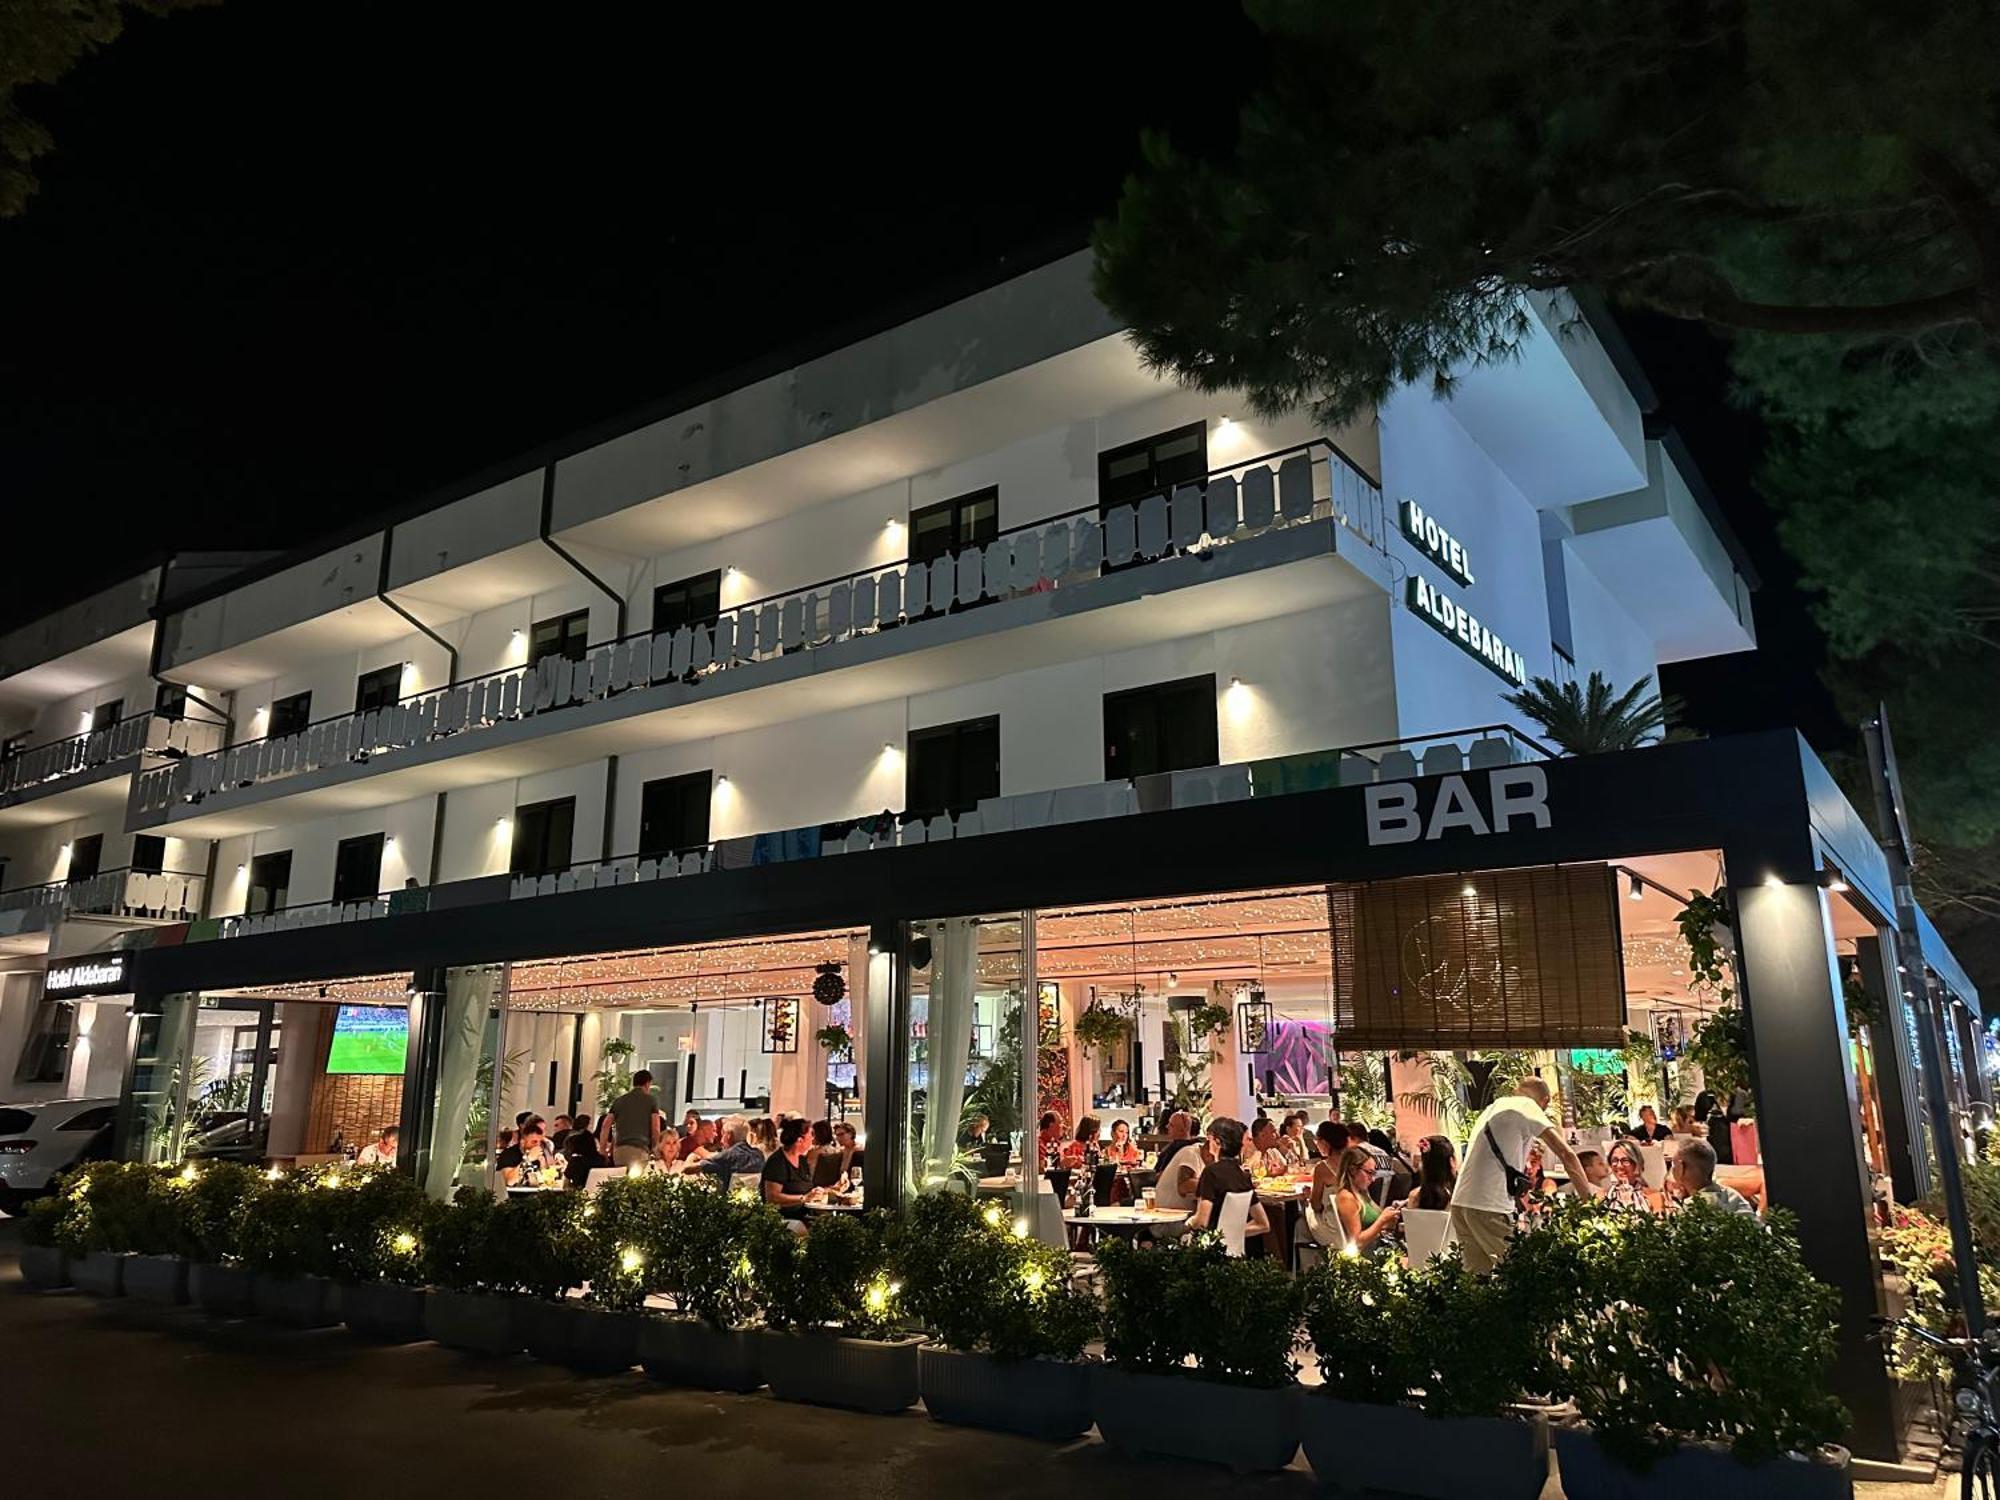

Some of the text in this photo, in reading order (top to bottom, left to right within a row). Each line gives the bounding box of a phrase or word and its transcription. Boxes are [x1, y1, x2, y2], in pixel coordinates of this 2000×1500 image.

[1410, 500, 1475, 584] HOTEL
[1416, 575, 1526, 685] ALDEBARAN
[1365, 766, 1552, 846] BAR
[46, 964, 122, 990] Hotel Aldebaran
